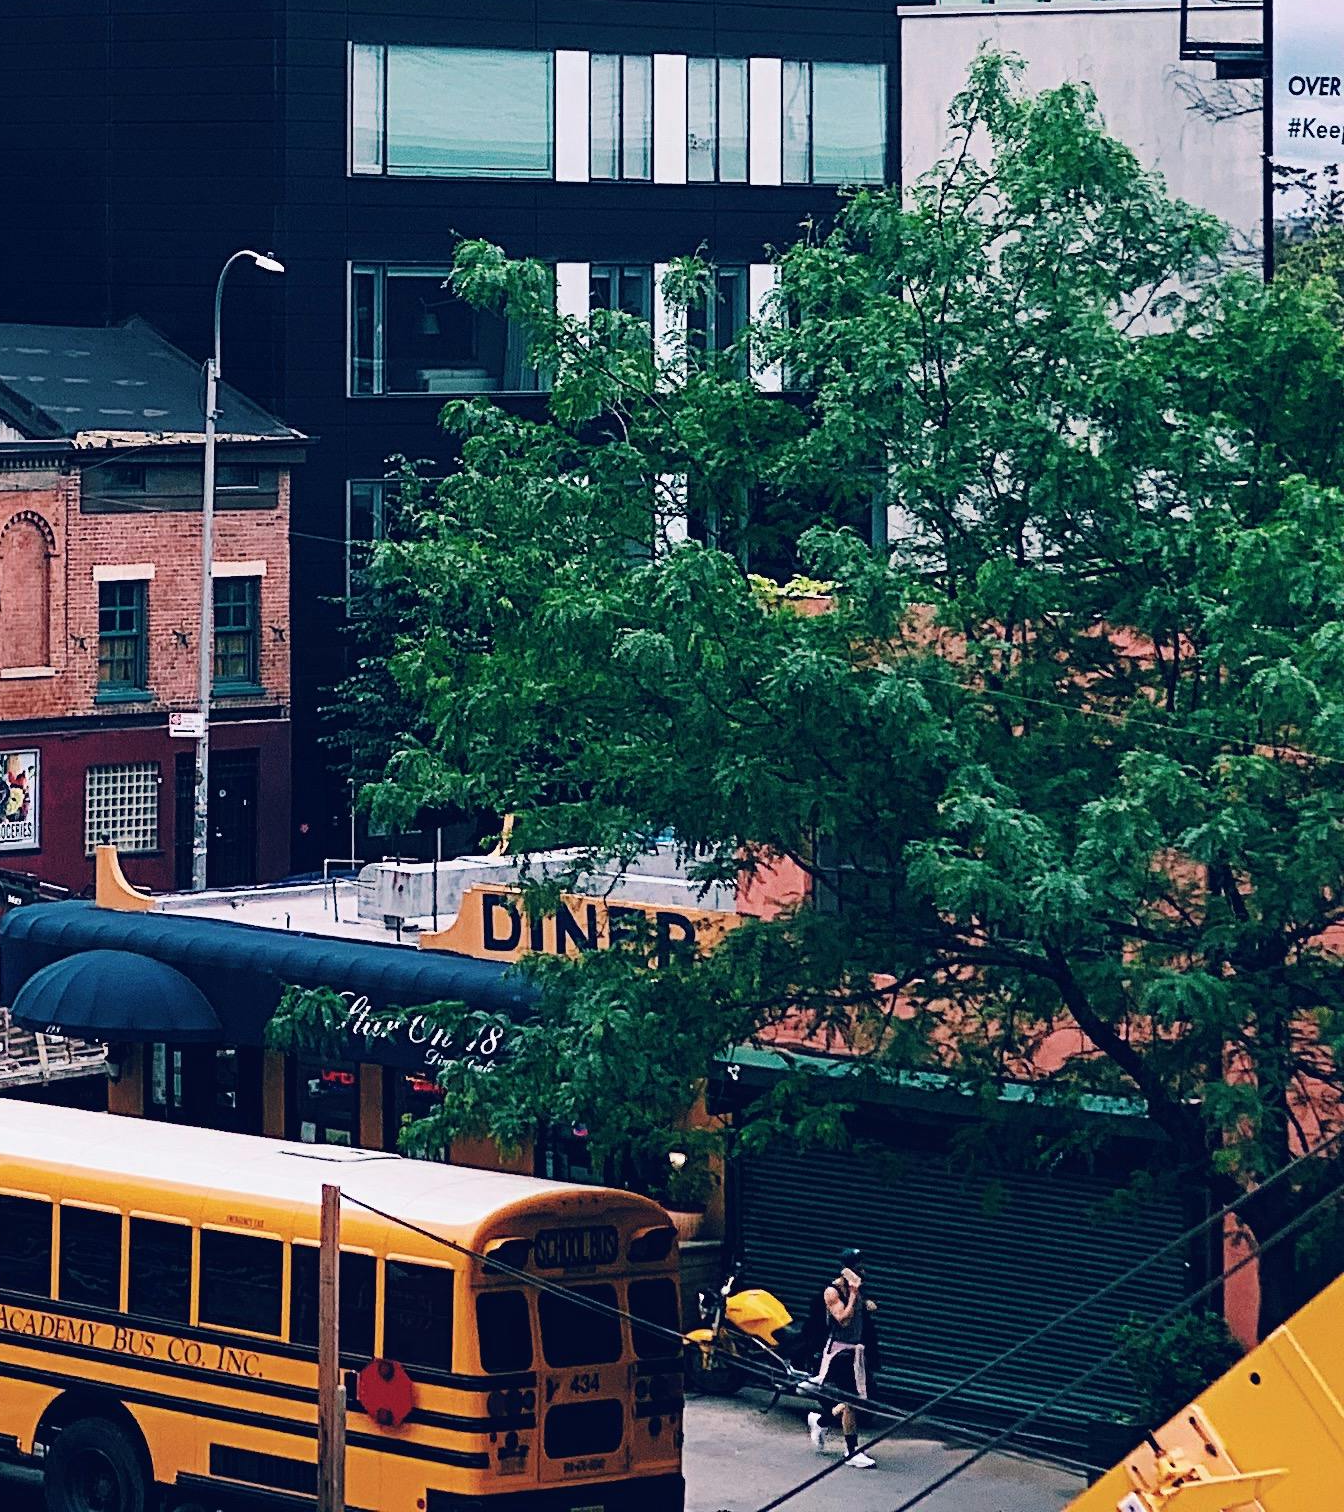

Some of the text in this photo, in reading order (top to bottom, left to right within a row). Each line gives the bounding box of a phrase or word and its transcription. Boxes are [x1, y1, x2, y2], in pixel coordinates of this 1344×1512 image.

[1288, 75, 1341, 96] OVER
[1288, 117, 1344, 145] #Kee
[408, 1014, 453, 1048] On
[537, 1230, 614, 1263] SCHOOL BUS
[113, 1326, 155, 1357] BUS
[167, 1338, 206, 1370] CO.
[218, 1345, 263, 1378] INC.
[569, 1374, 600, 1394] 434
